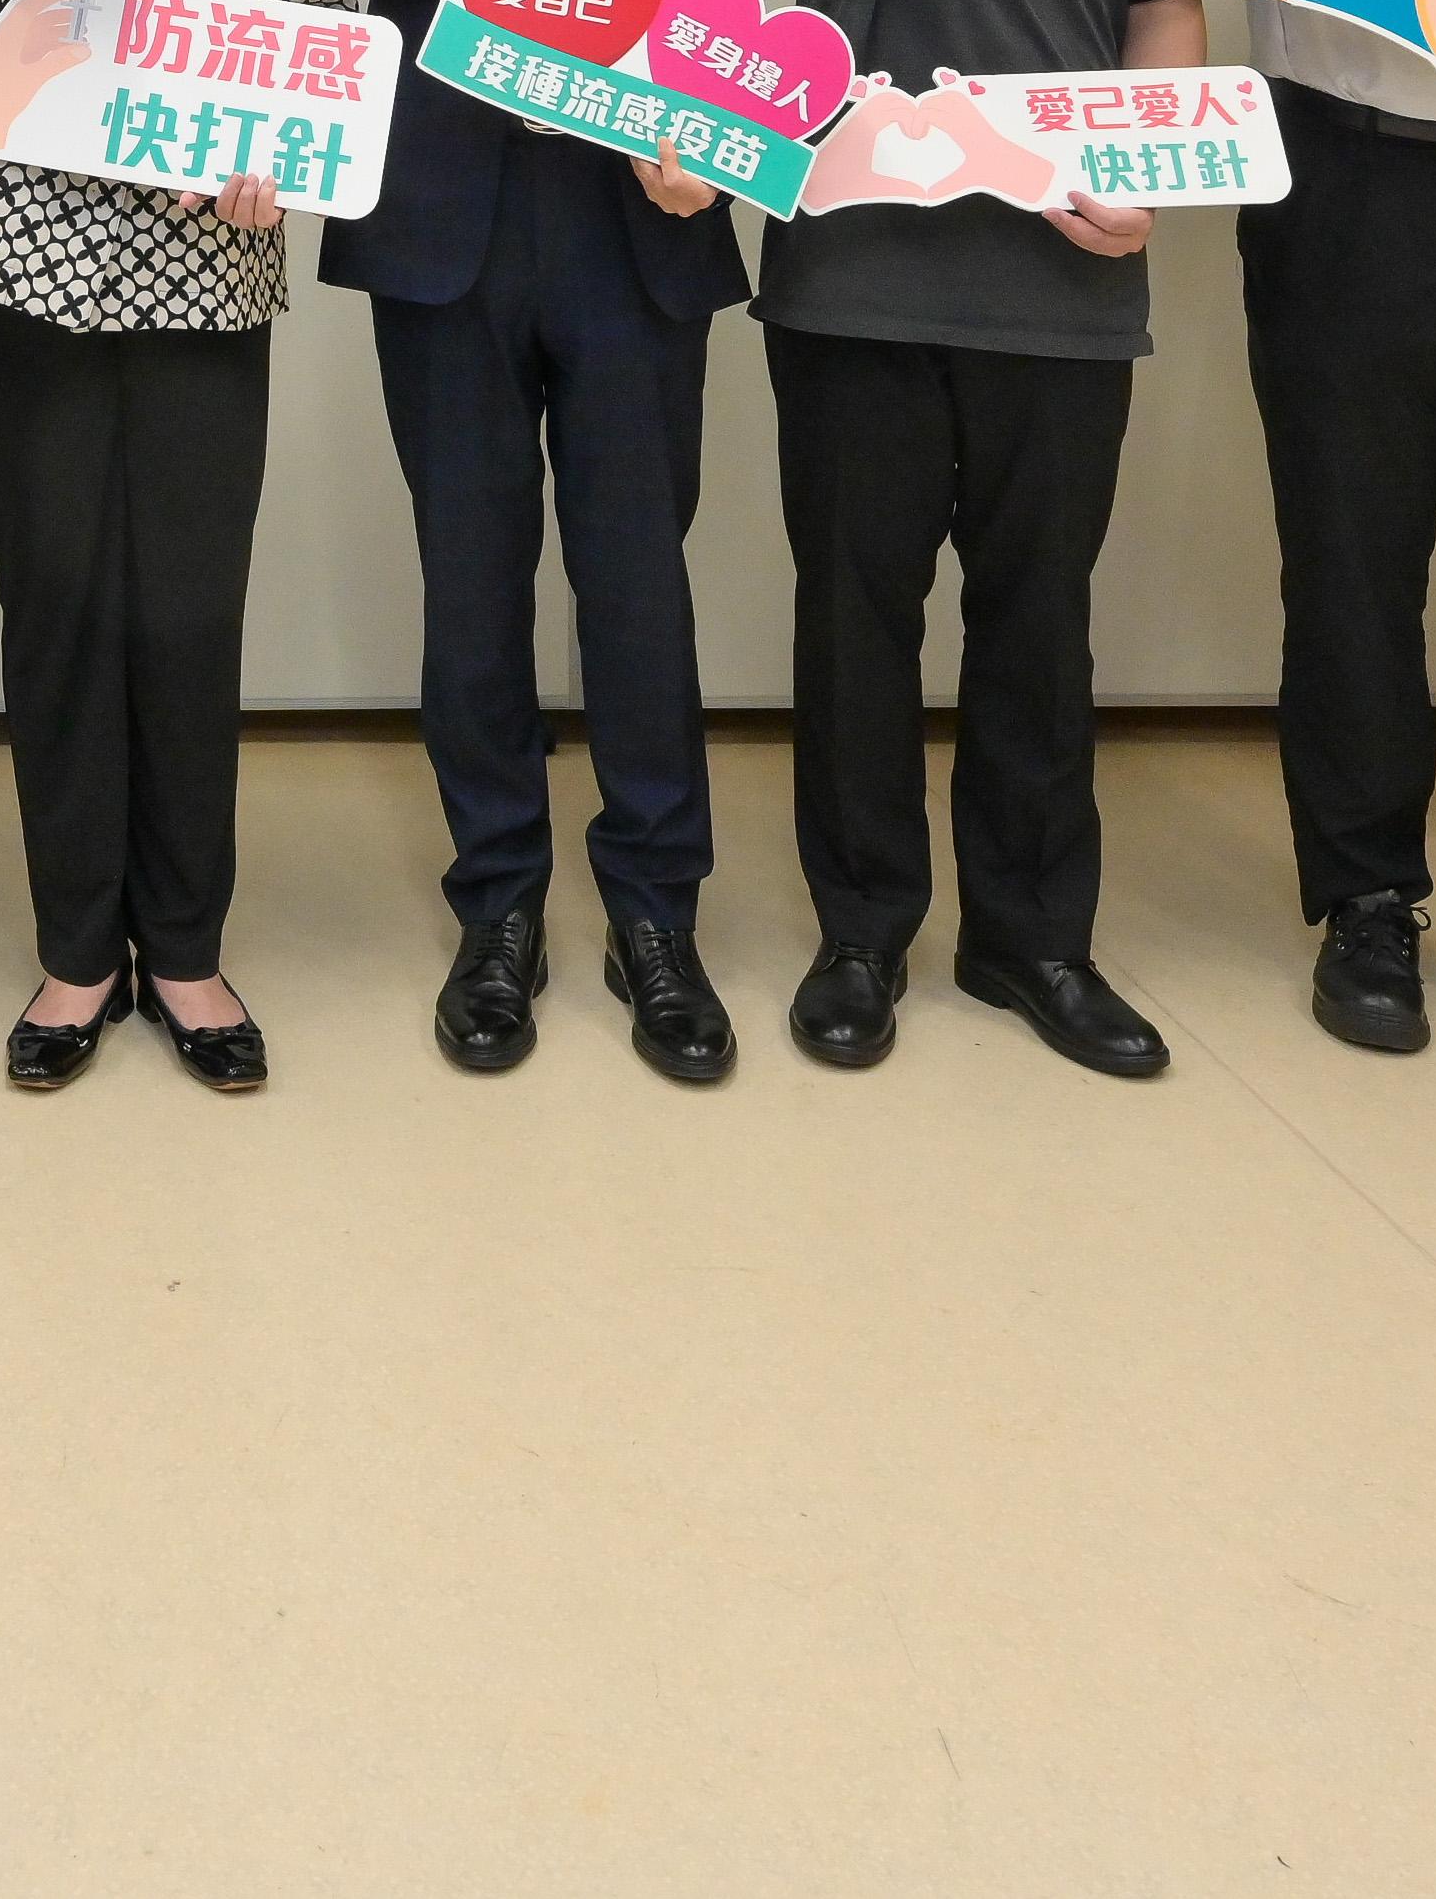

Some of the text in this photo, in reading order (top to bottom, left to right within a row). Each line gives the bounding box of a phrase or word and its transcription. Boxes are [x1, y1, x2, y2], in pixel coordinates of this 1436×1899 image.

[462, 33, 770, 183] 接種流感疫苗
[659, 11, 813, 124] 愛身邊人
[1026, 82, 1240, 133] 愛己愛人
[99, 86, 352, 202] 快打針
[1080, 138, 1249, 194] 快打針
